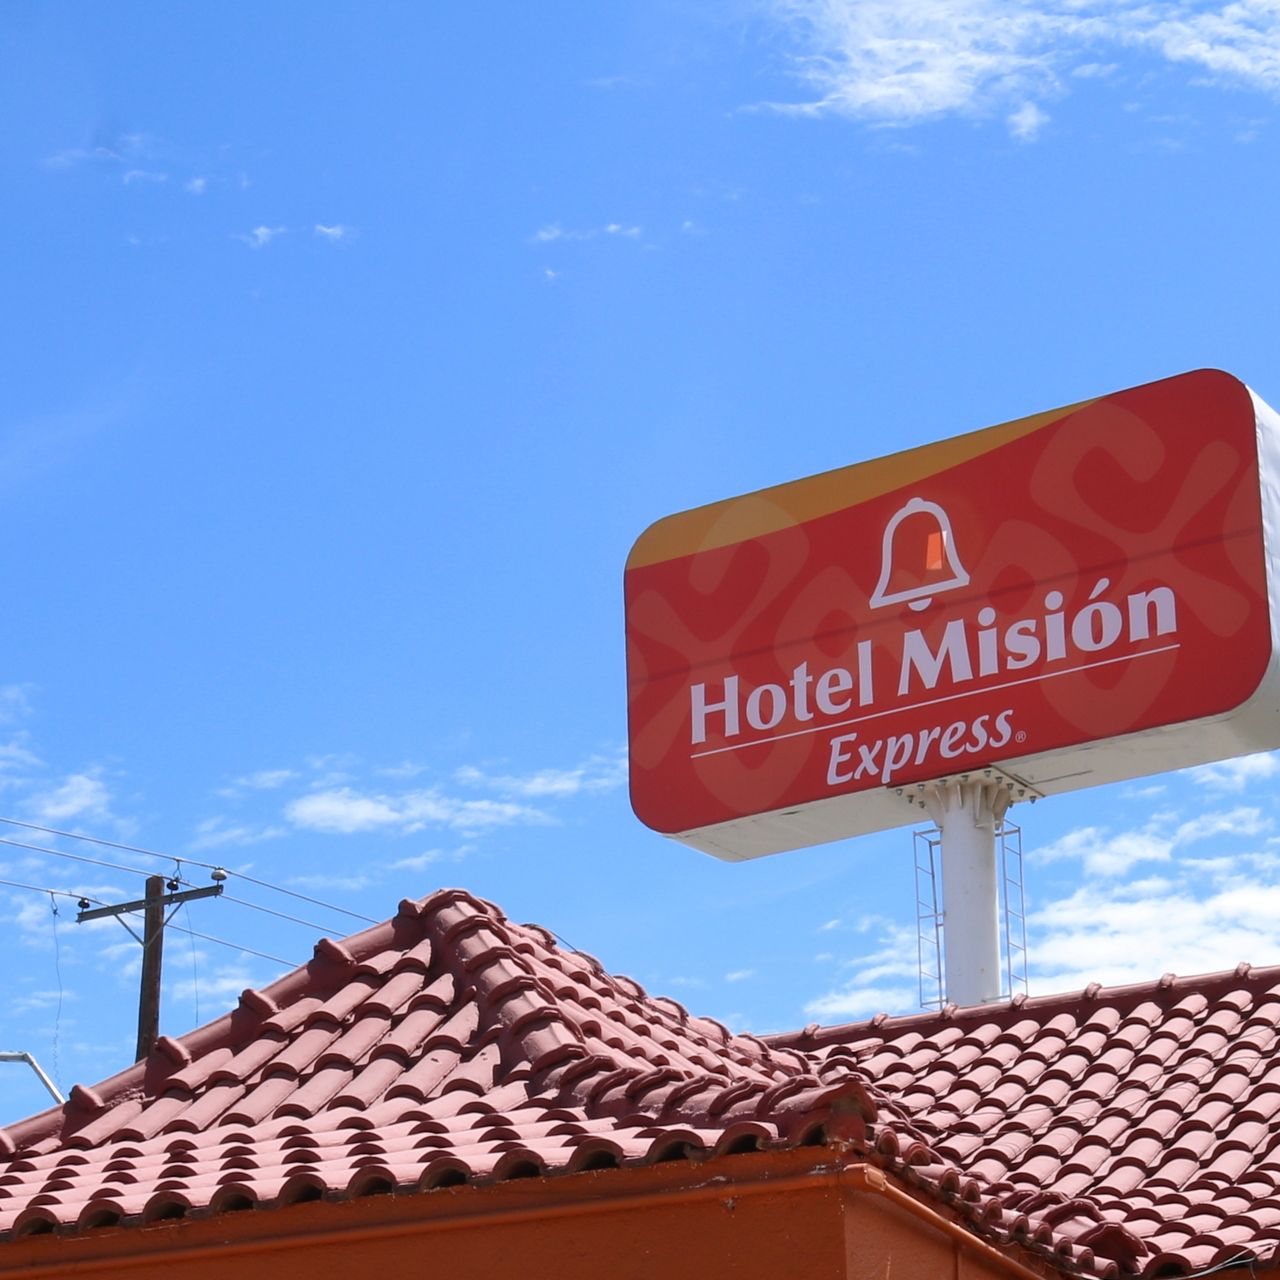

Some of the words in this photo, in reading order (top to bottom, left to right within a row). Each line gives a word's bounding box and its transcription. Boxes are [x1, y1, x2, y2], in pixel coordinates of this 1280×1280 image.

[690, 640, 874, 745] Hotel
[896, 578, 1178, 696] Misión
[826, 708, 1014, 785] Express
